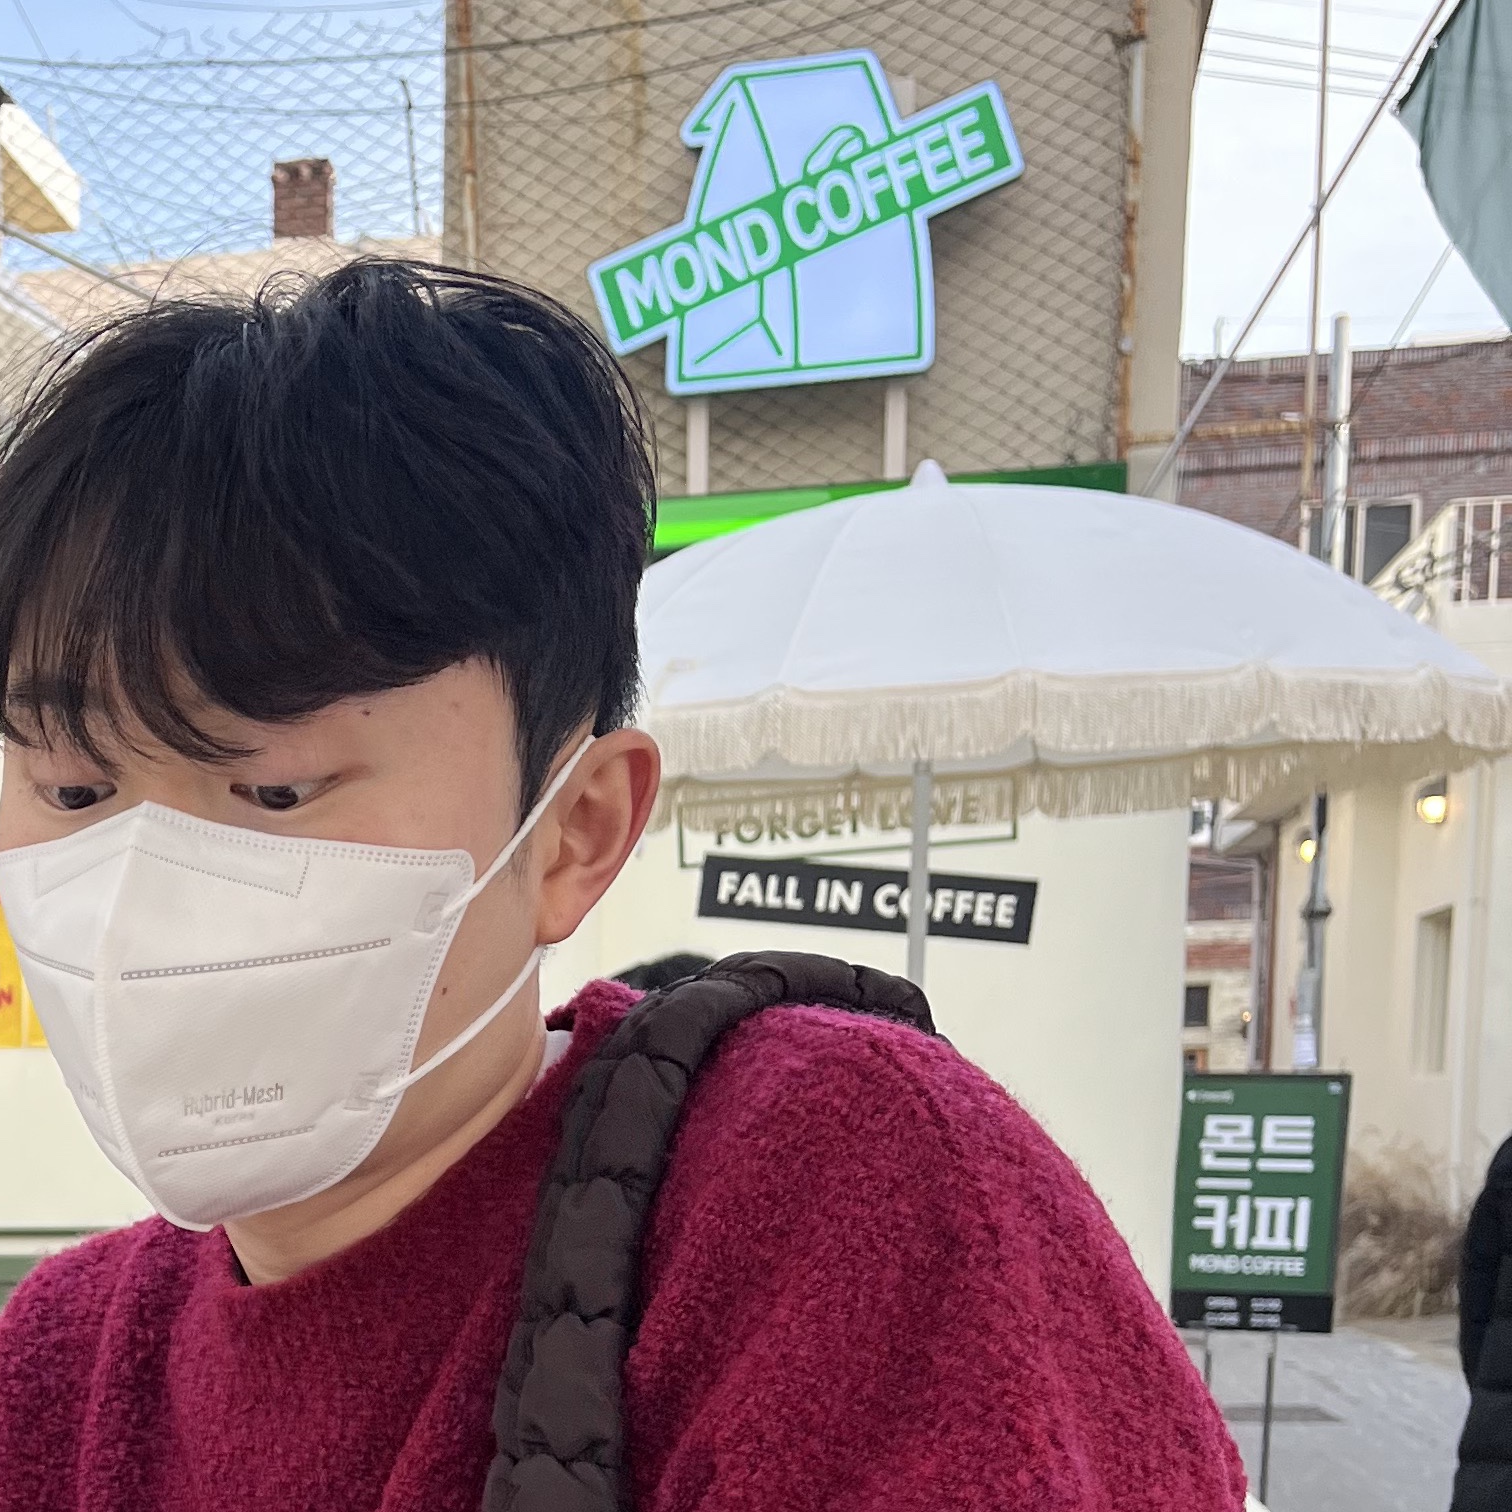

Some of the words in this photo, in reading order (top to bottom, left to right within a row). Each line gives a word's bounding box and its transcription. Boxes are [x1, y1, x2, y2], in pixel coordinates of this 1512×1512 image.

[614, 208, 781, 329] MOND
[783, 108, 994, 250] COFFEE
[717, 871, 804, 911] FALL
[815, 878, 863, 915] IN
[183, 1083, 284, 1117] Hybrid-Mesh
[1199, 1114, 1315, 1173] 몬트
[1192, 1194, 1311, 1252] 커피
[1188, 1254, 1240, 1275] MOND
[1241, 1255, 1306, 1277] COFFEE
